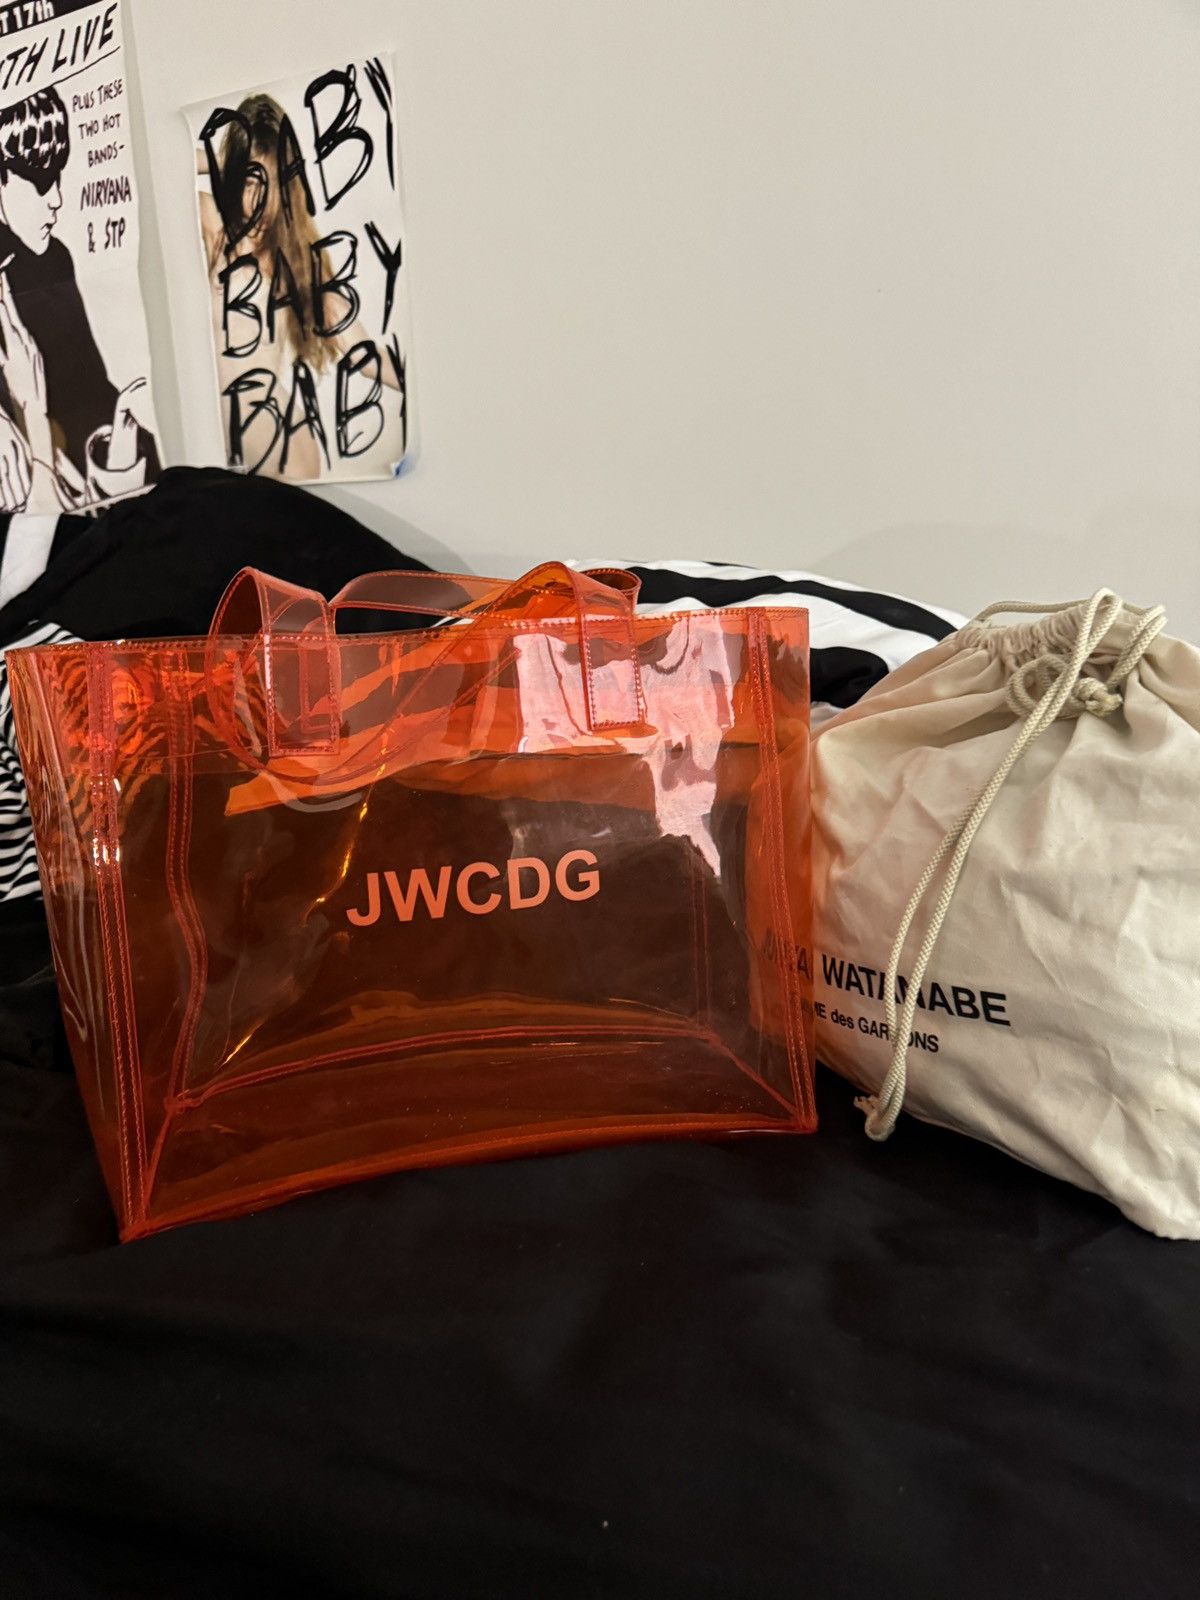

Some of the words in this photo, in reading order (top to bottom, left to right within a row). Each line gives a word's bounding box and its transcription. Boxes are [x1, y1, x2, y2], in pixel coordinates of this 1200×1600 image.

[52, 3, 118, 73] LIVE
[72, 91, 95, 113] PLUS
[98, 79, 123, 105] THESE
[78, 120, 99, 140] TWO
[102, 113, 121, 132] HOT
[198, 57, 395, 254] BABY
[87, 221, 96, 254] &
[104, 216, 126, 250] STP
[218, 222, 402, 358] BABY
[222, 333, 407, 476] BABY
[346, 850, 600, 926] JWCDG
[831, 1008, 855, 1029] des
